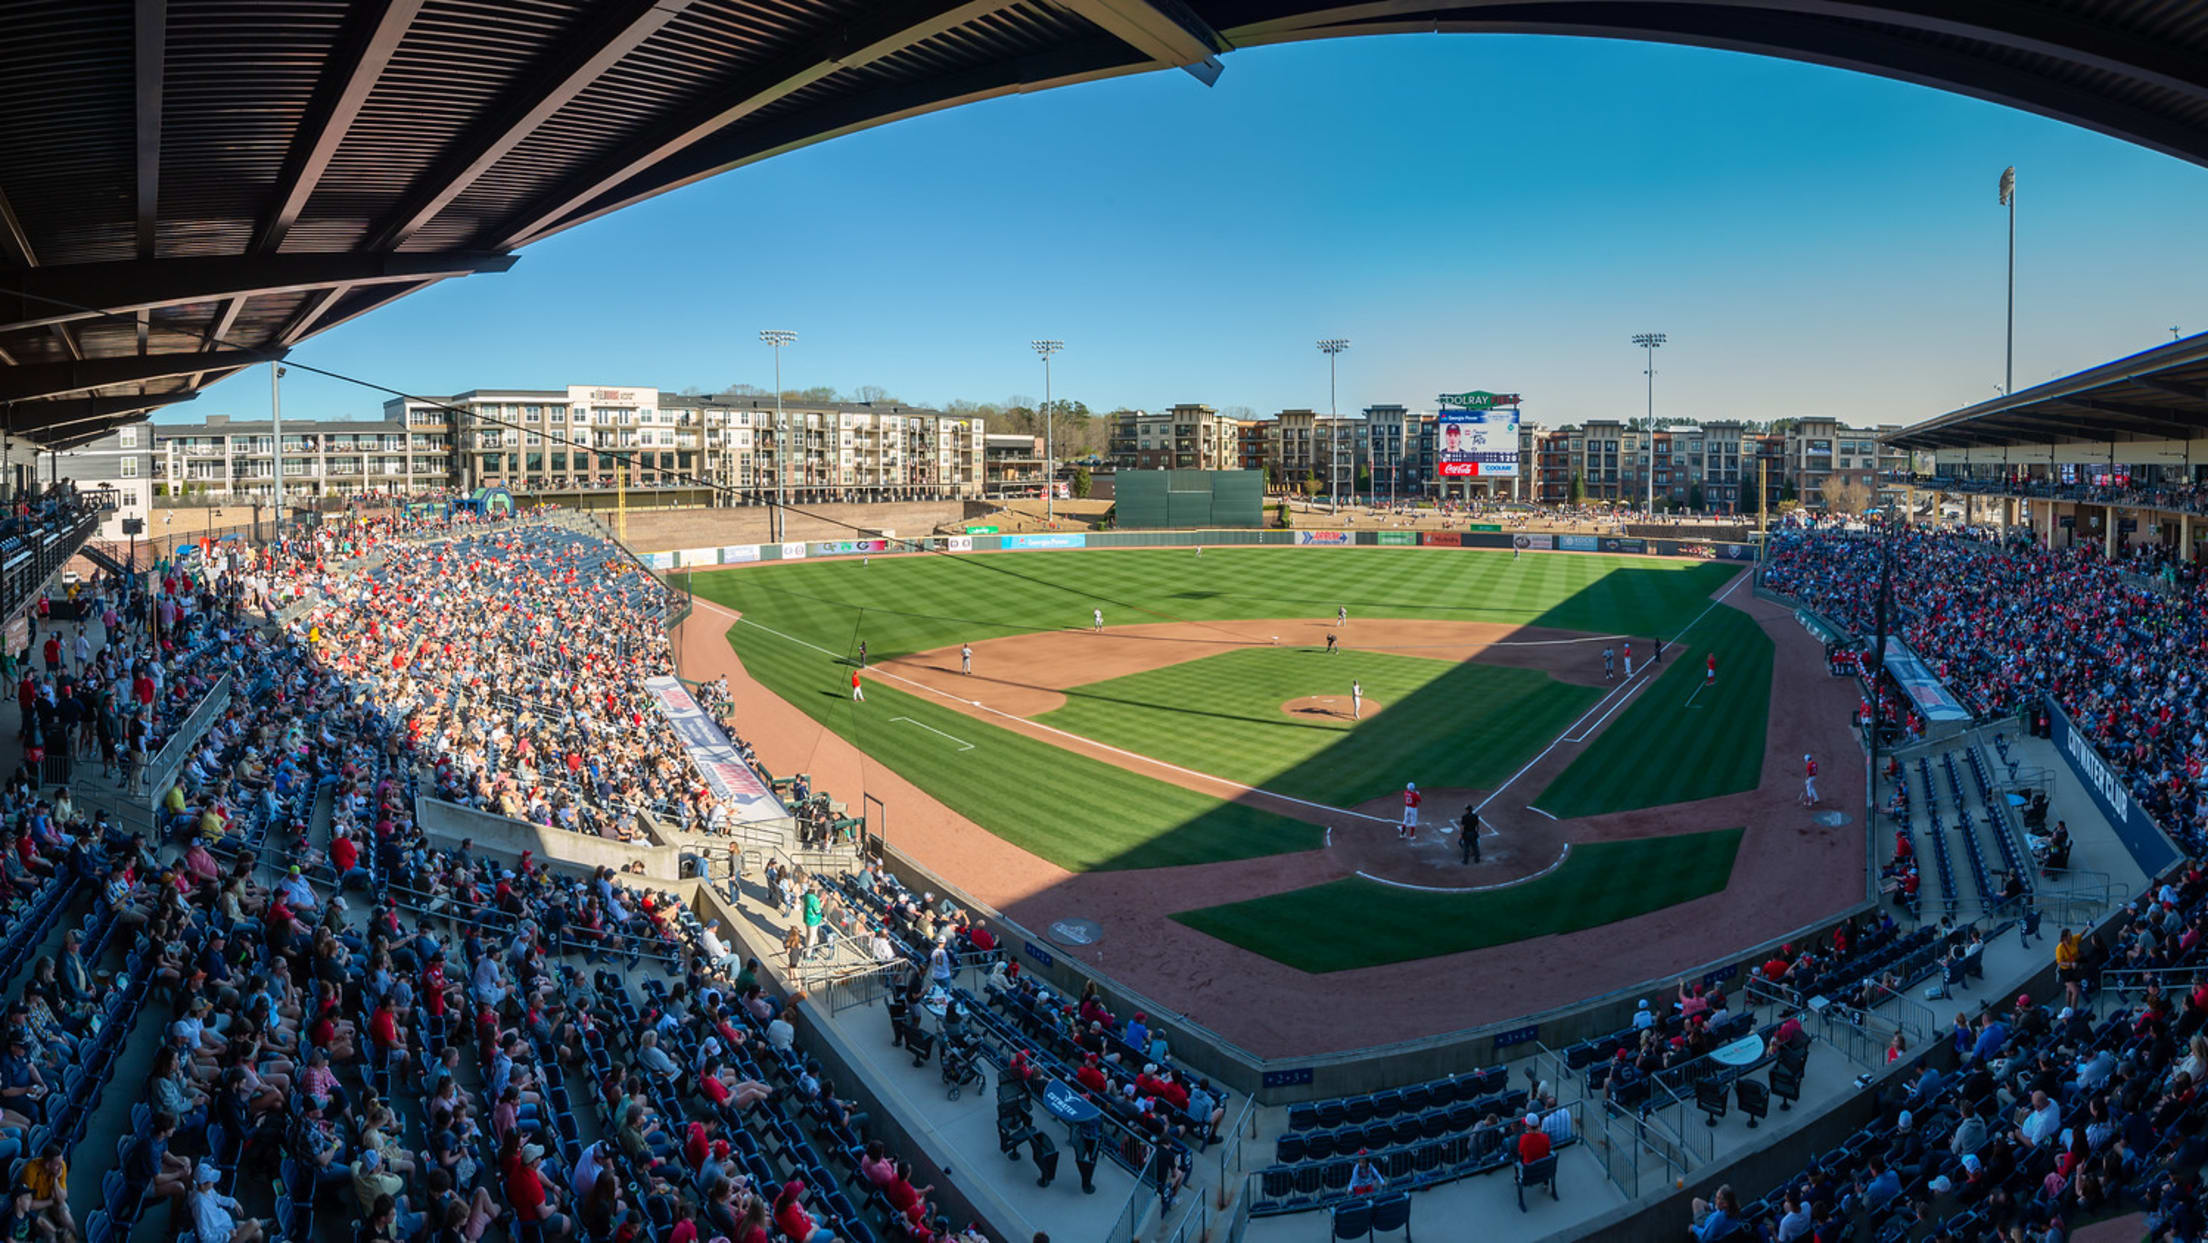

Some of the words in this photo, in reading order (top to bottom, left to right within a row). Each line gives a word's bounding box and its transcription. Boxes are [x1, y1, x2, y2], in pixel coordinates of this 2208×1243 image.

[1439, 395, 1488, 404] COOLRAY
[1490, 395, 1520, 405] FIELD
[2067, 725, 2105, 795] CUTWATER
[2105, 771, 2128, 821] CLUB
[1047, 1092, 1078, 1117] CUTWATER
